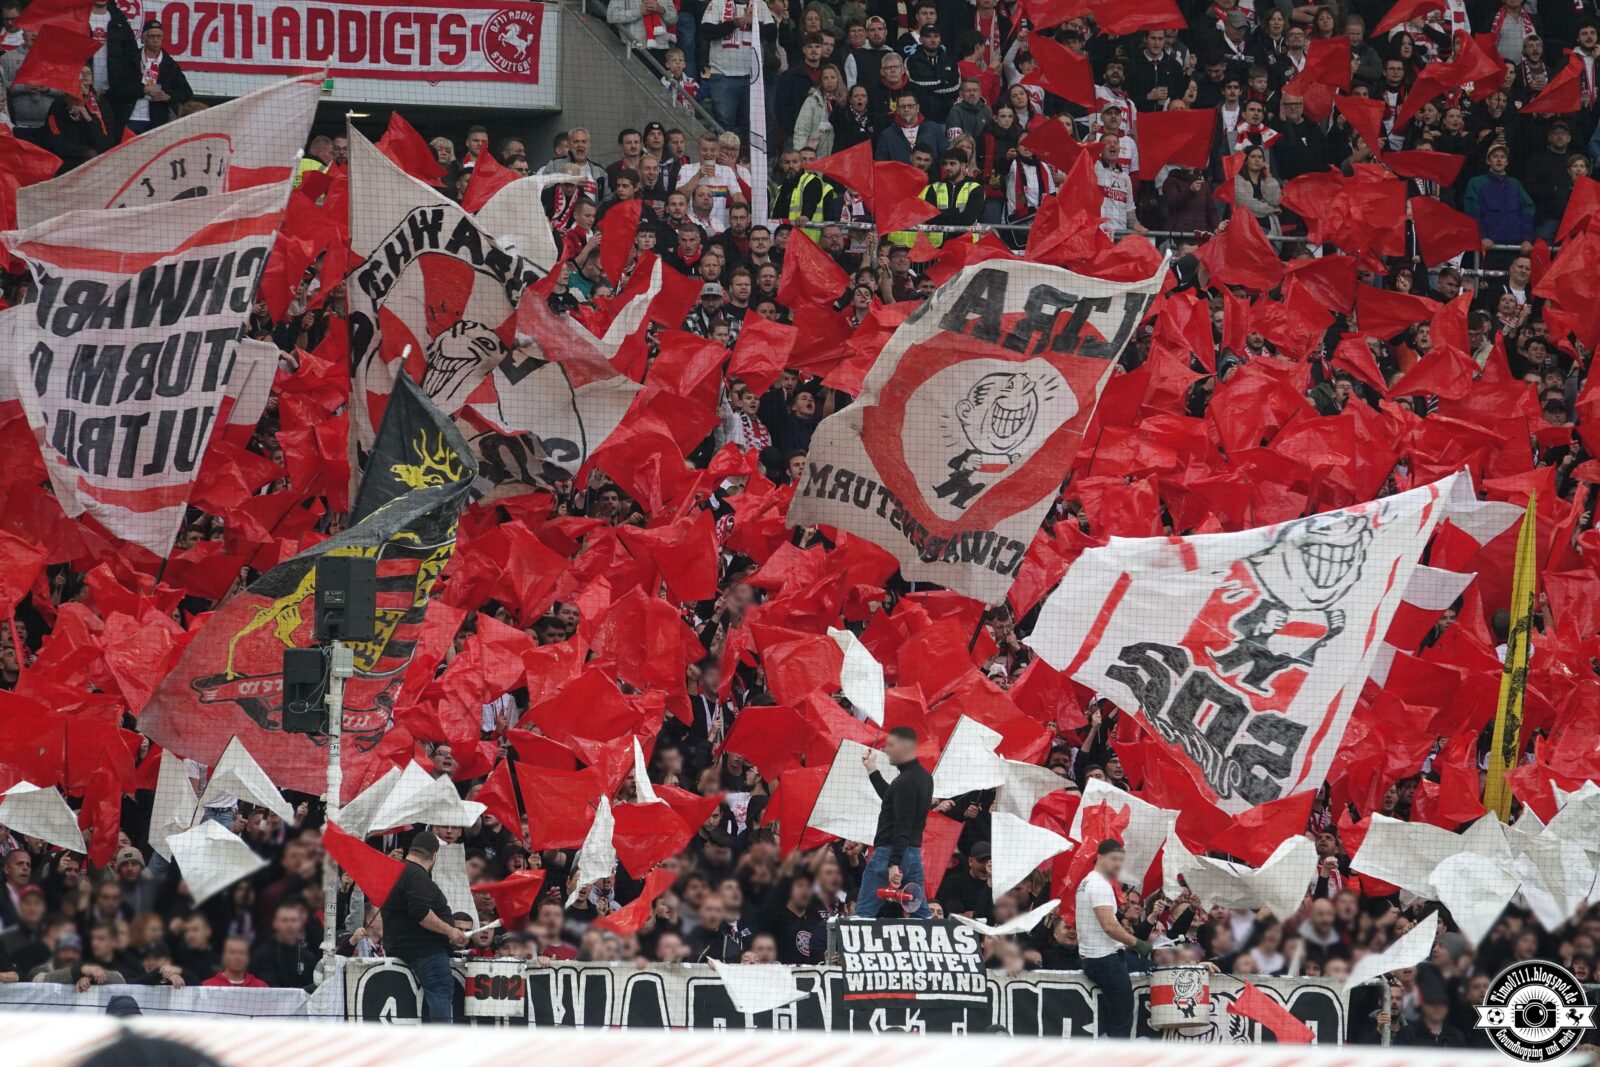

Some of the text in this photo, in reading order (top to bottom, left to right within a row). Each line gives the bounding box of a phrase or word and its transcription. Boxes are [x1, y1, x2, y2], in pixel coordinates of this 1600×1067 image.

[839, 924, 978, 954] ULTRAS
[844, 952, 981, 973] BEDEUTET
[846, 971, 986, 993] WIDERSTAND
